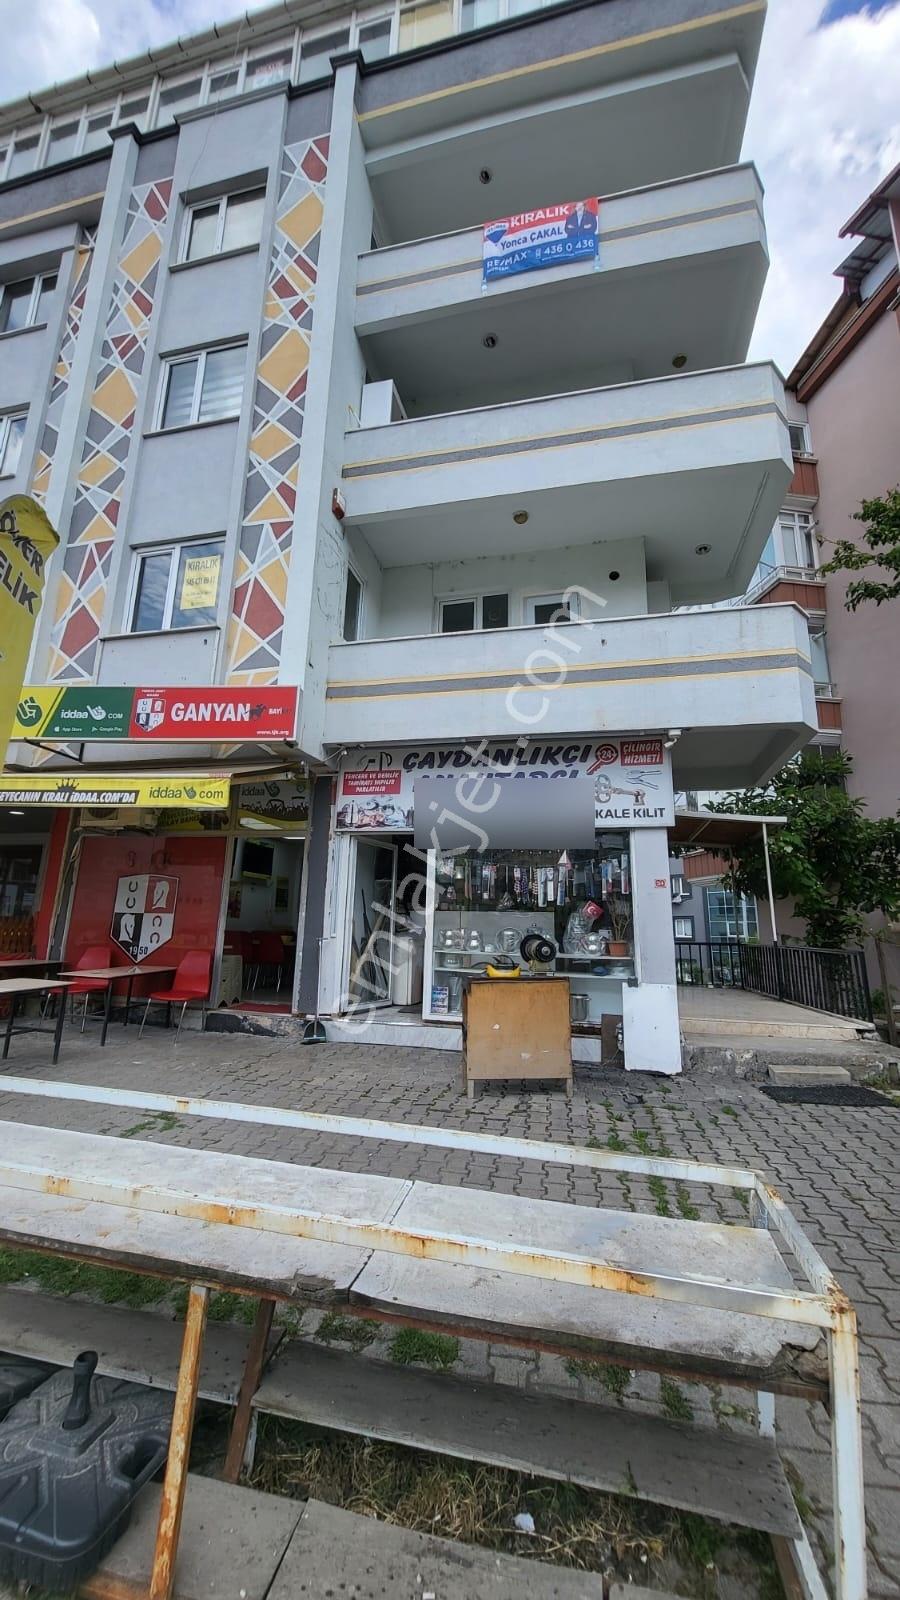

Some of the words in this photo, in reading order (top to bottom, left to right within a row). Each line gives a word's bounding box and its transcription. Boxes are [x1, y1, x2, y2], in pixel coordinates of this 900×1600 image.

[501, 237, 528, 251] Yonca
[530, 226, 564, 243] ÇAKAL
[486, 251, 528, 268] RE/MAX
[544, 244, 563, 255] 436
[575, 239, 594, 249] 436
[60, 709, 88, 719] iddaa
[171, 702, 251, 722] GANYAN
[402, 744, 593, 773] ÇAYDANLIKÇI
[148, 786, 182, 799] iddaa
[199, 789, 224, 799] com
[595, 808, 631, 819] KALE
[129, 946, 149, 955] 1950
